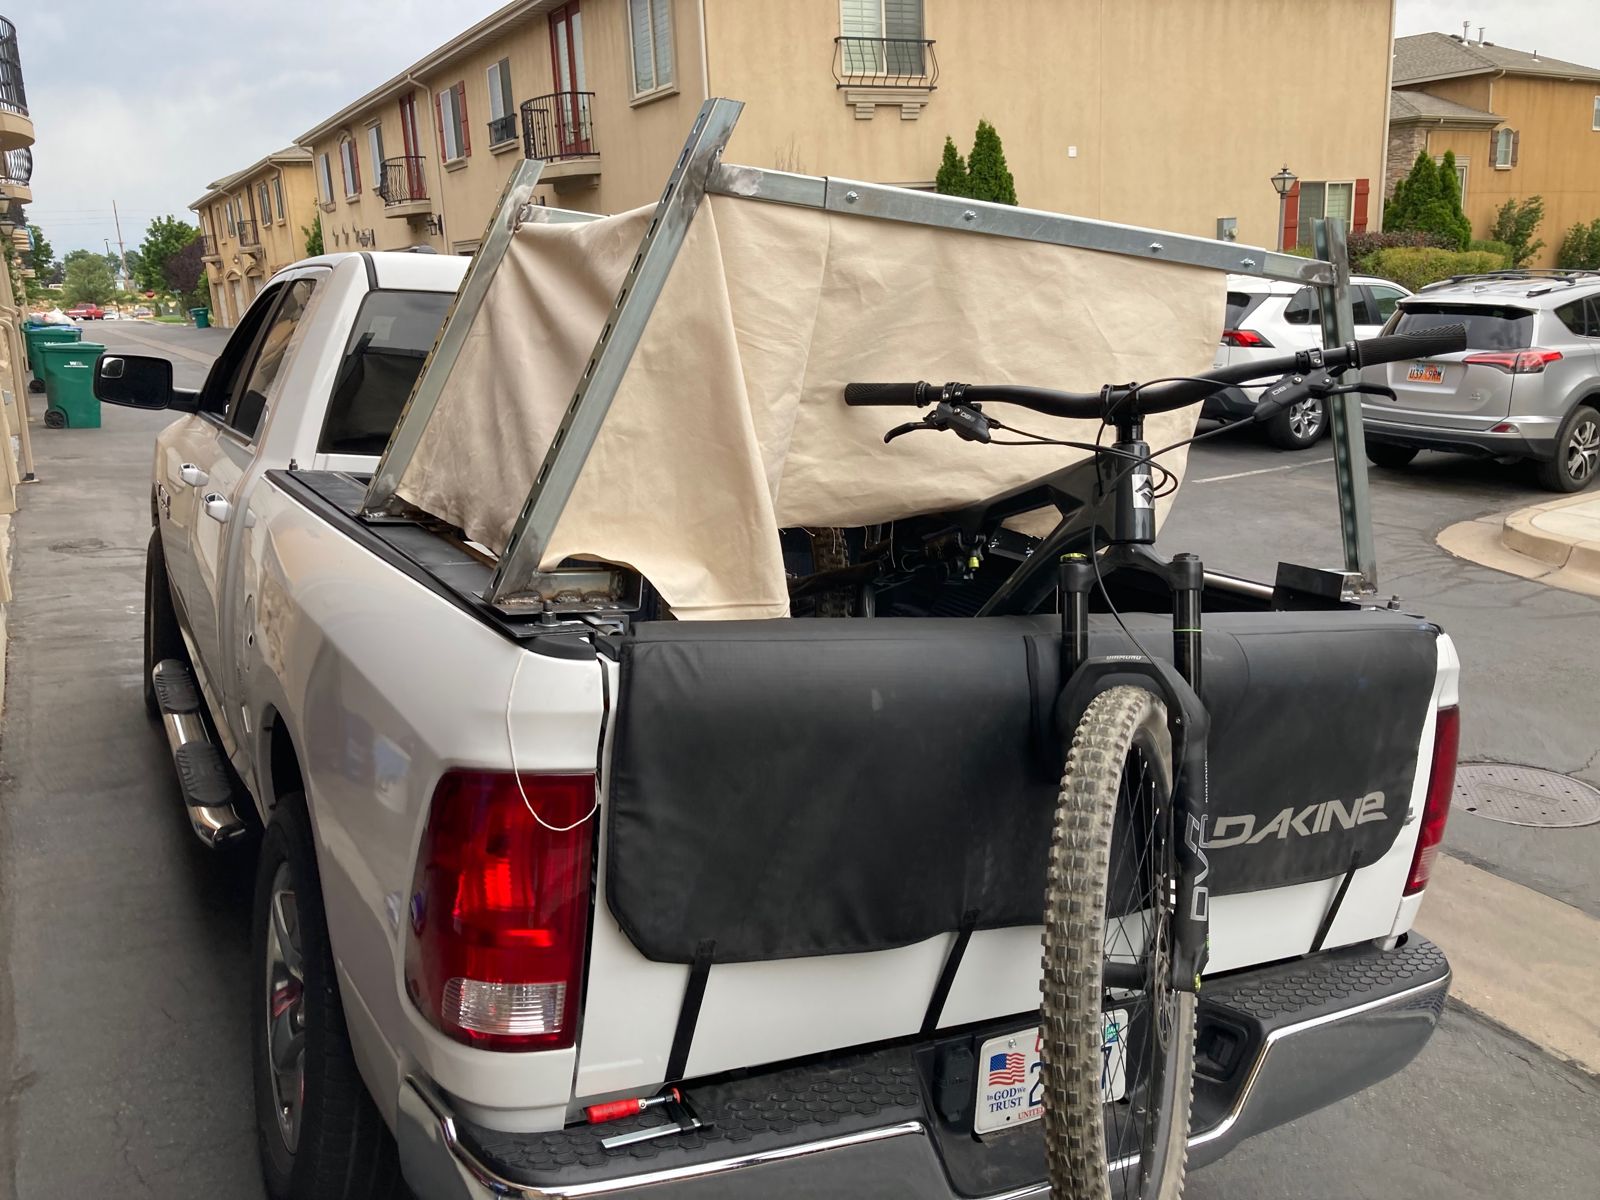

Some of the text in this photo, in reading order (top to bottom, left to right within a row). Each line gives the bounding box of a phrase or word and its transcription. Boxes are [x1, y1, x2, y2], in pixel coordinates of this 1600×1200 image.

[1207, 791, 1388, 849] DAKINE
[994, 1087, 1017, 1101] GOD
[989, 1096, 1023, 1113] TRUST
